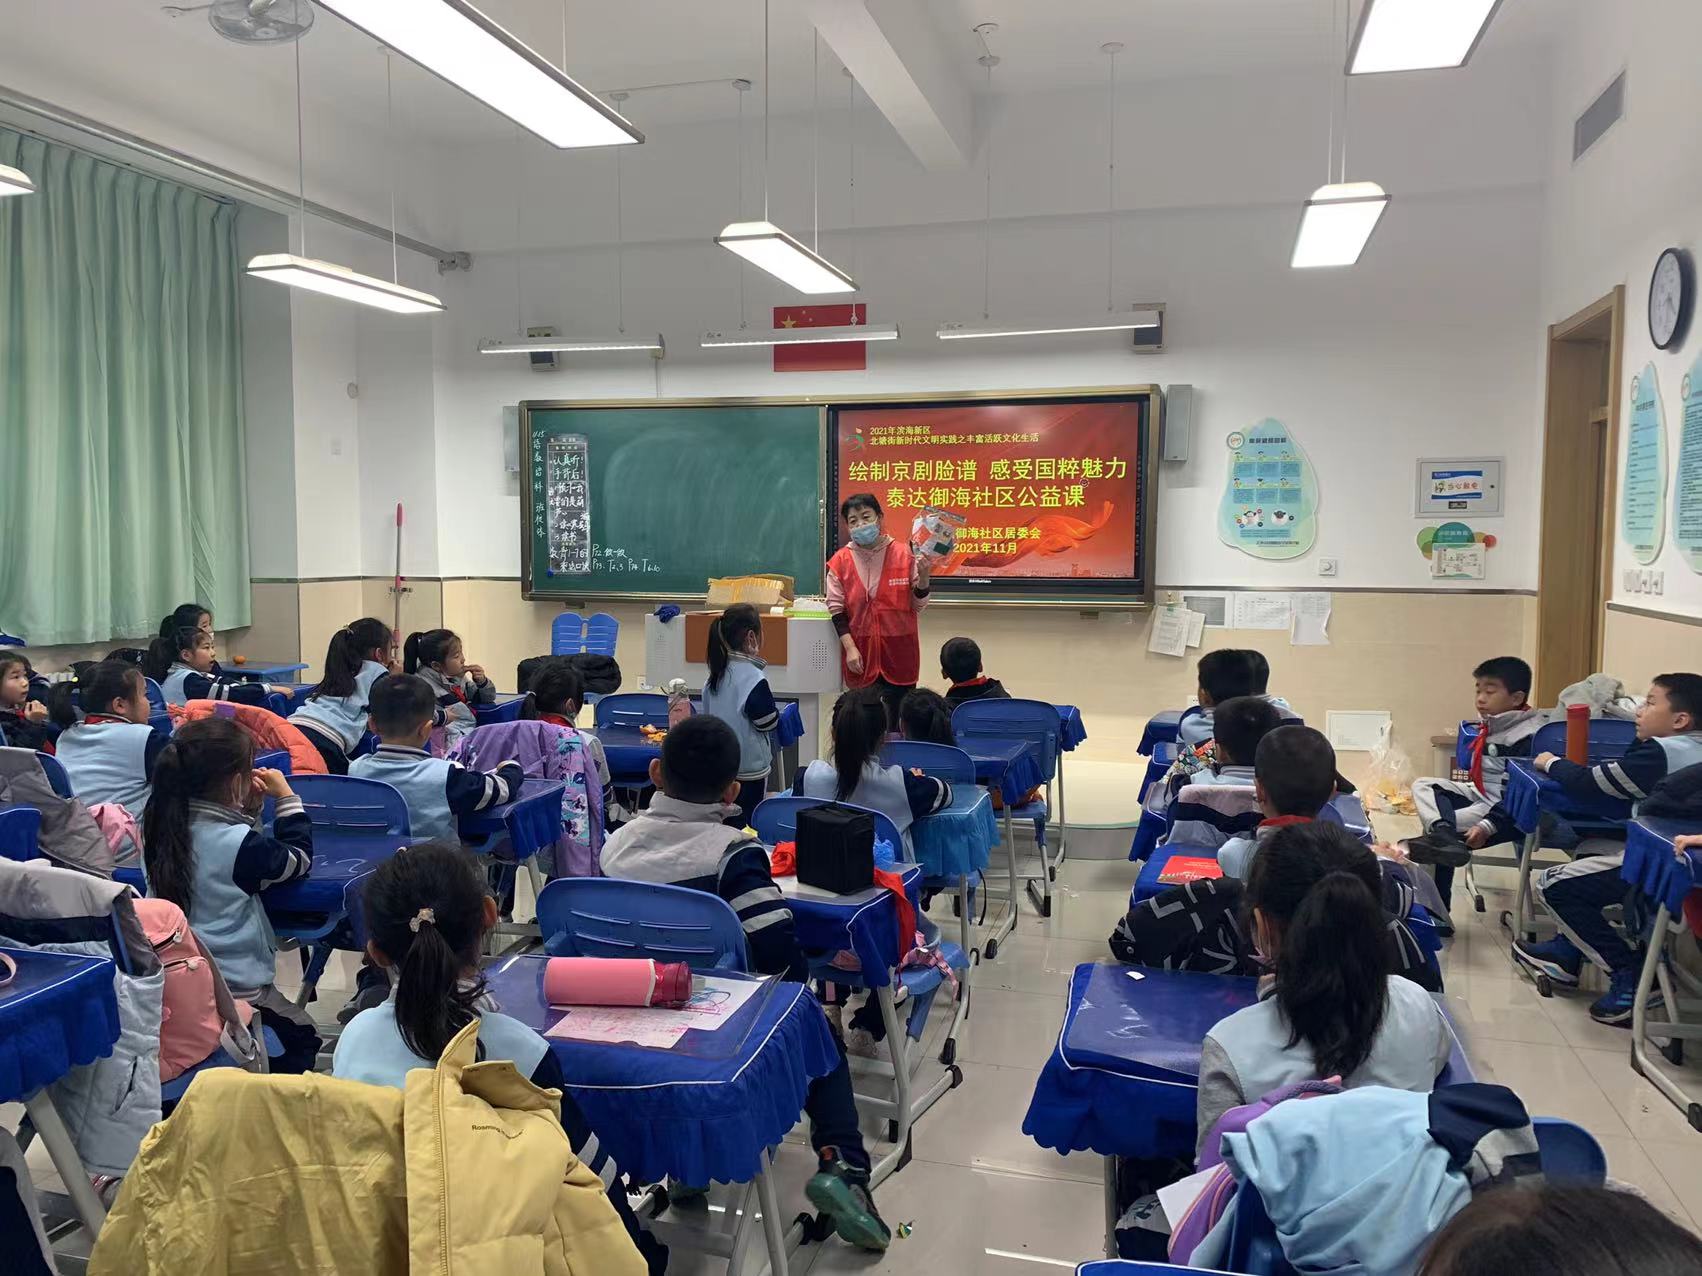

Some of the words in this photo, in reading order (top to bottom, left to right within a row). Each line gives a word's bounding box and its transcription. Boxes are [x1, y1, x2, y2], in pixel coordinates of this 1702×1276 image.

[869, 426, 931, 436] 2021年滨海新区
[869, 433, 1039, 446] 北塘街新时代文明实践之丰富活跃文化生活
[848, 459, 977, 482] 绘制京剧脸谱
[989, 456, 1127, 480] 感受国粹魅力
[886, 484, 1086, 508] 泰达御海社区公益课
[955, 527, 1042, 540] 御海社区居委会
[953, 542, 1018, 554] 2021年11月
